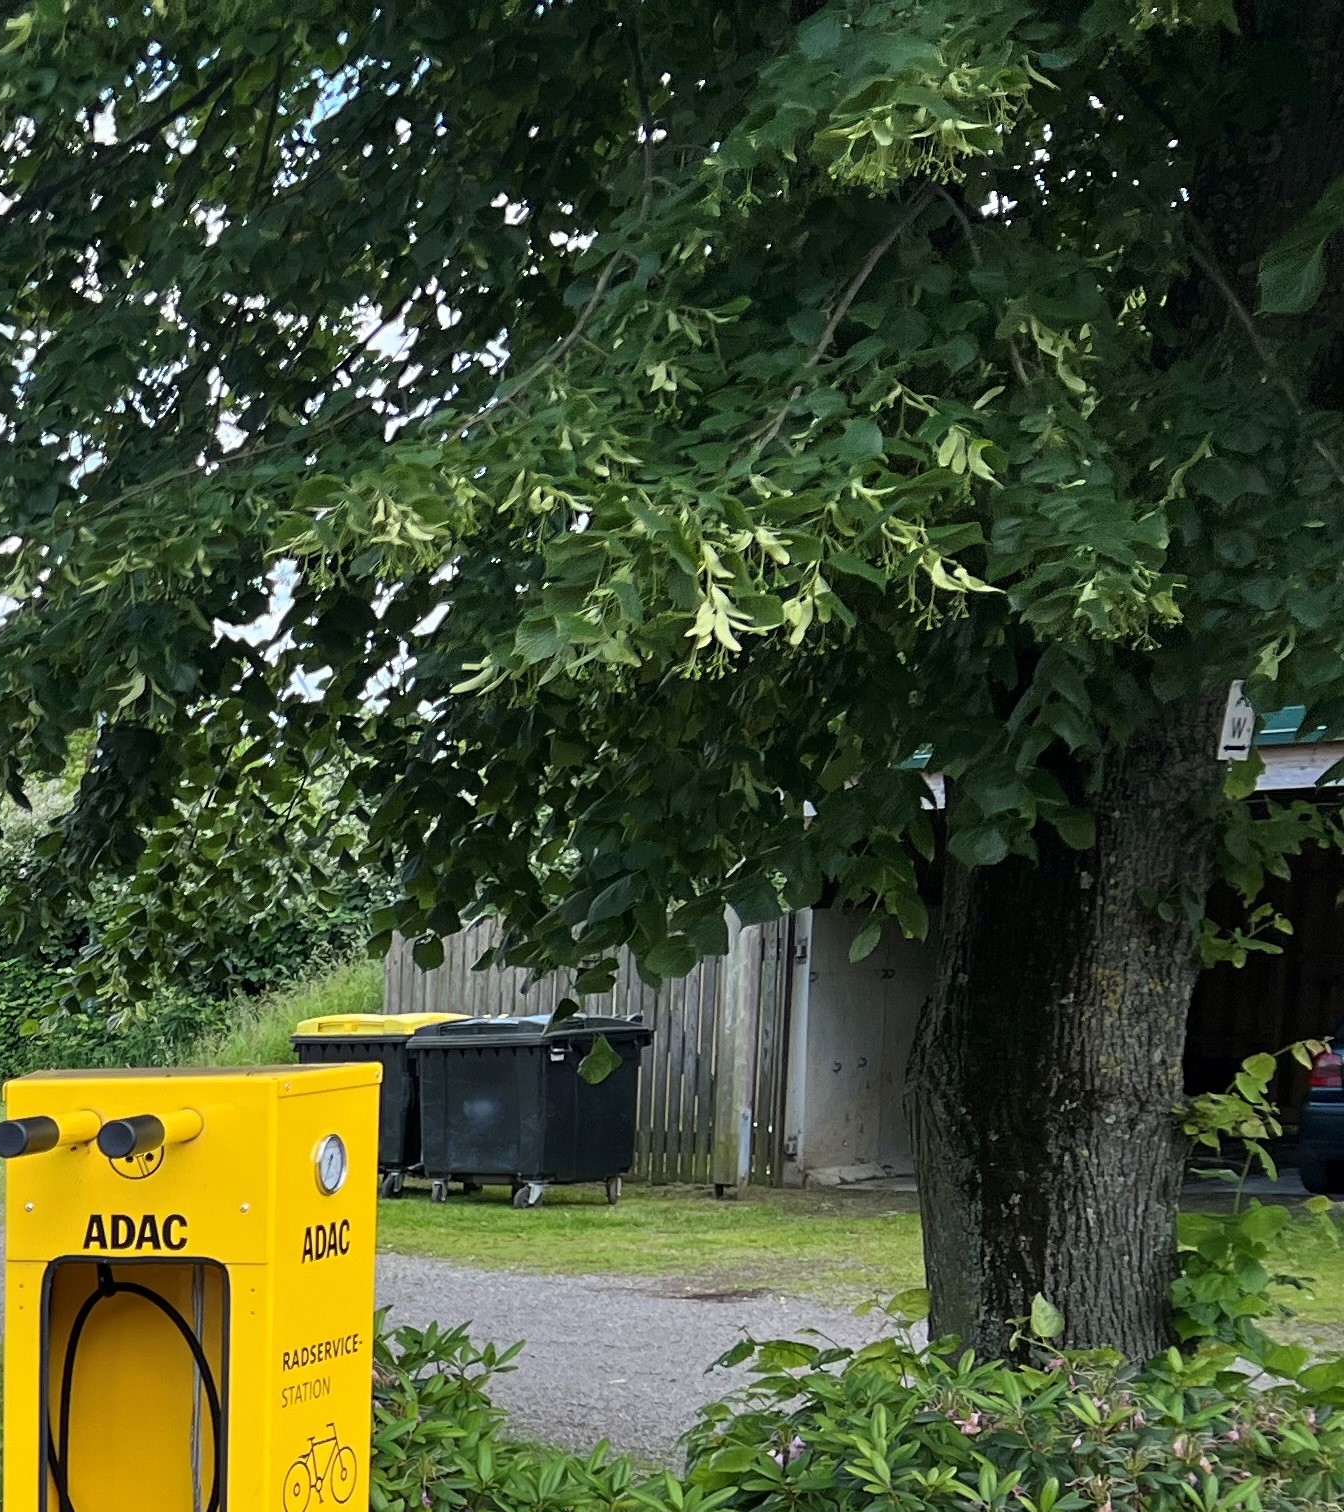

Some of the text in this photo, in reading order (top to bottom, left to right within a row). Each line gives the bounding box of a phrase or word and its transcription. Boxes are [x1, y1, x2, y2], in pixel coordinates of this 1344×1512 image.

[83, 1214, 188, 1251] ADAC
[301, 1218, 351, 1264] ADAC
[282, 1333, 363, 1372] RADSERVICE-
[281, 1376, 331, 1409] STATION
